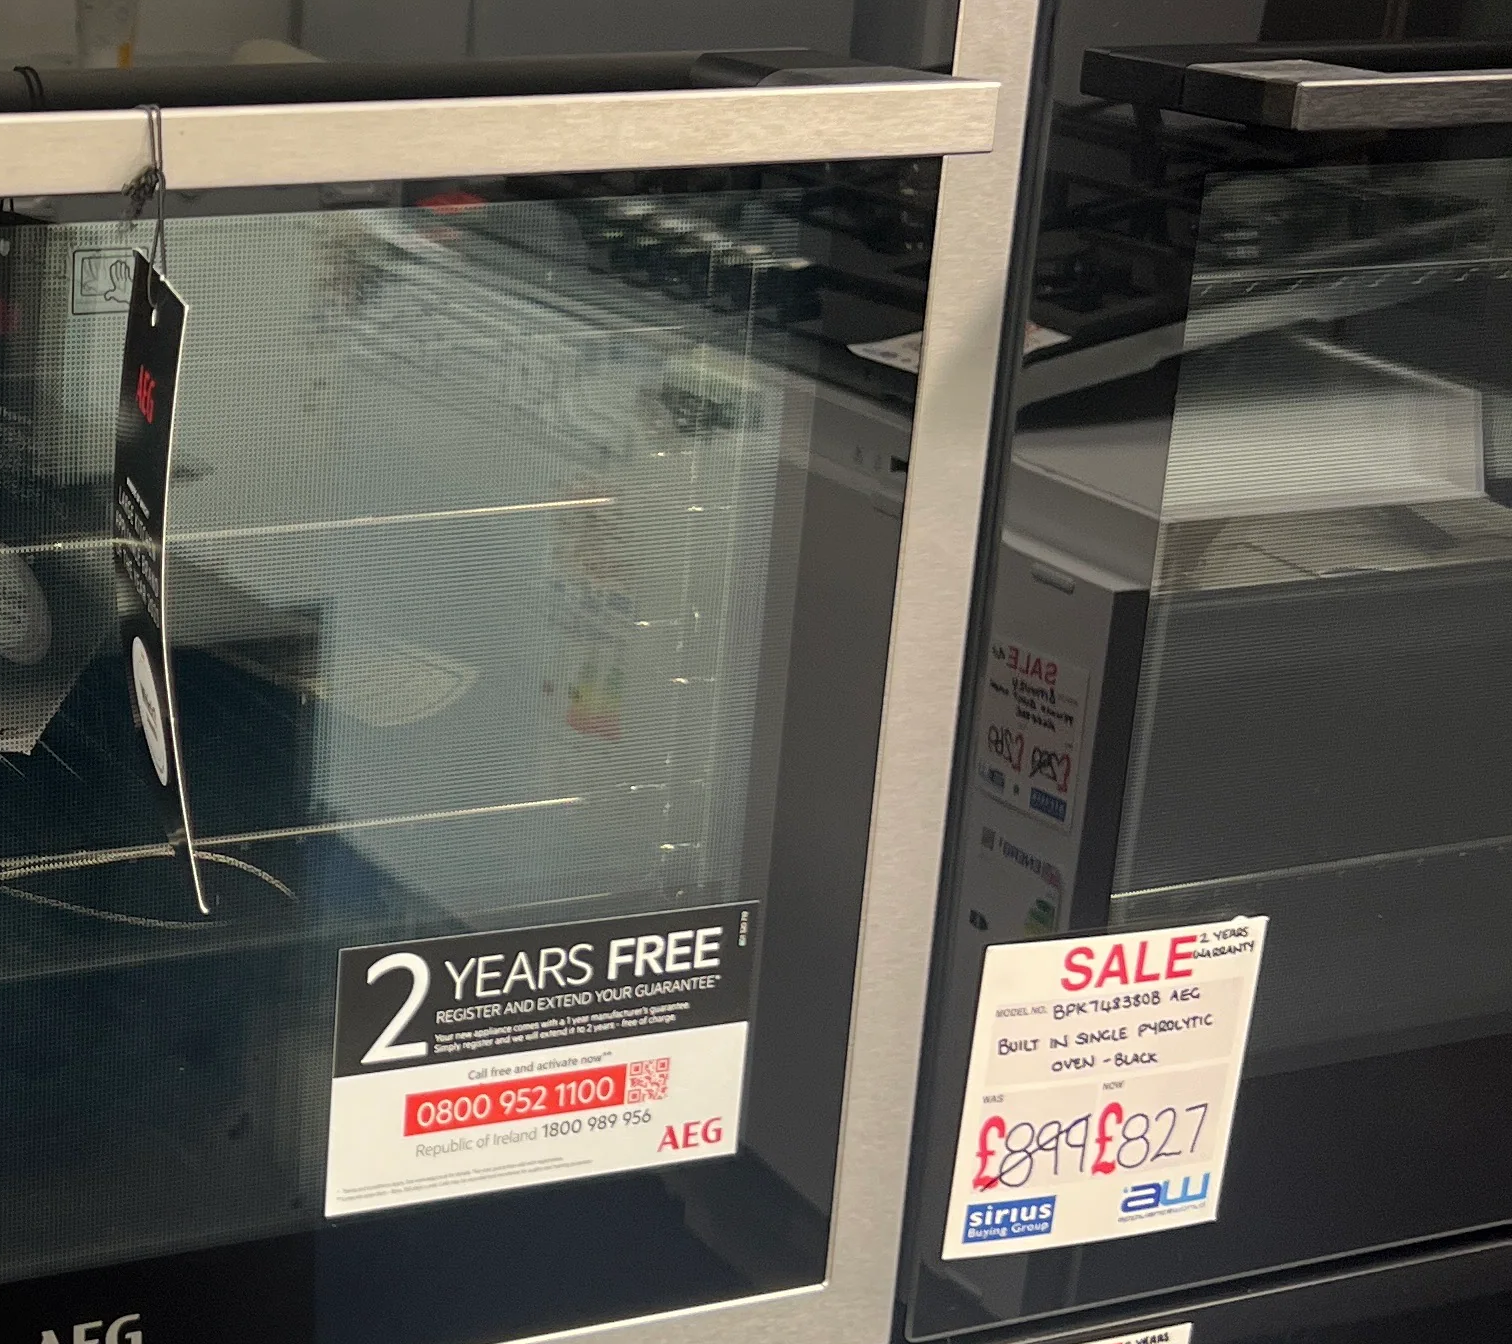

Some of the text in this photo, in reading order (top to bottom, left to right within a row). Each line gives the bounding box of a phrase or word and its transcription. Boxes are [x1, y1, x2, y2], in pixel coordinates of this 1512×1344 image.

[1060, 935, 1198, 992] SALE
[359, 951, 431, 1066] 2
[444, 942, 595, 1001] YEARS
[606, 926, 725, 982] FREE
[435, 1003, 502, 1024] REGISTER
[503, 999, 535, 1015] AND
[536, 990, 592, 1011] EXTEND
[594, 985, 633, 1003] YOUR
[997, 1037, 1039, 1056] BUILT
[1049, 1034, 1069, 1050] IN
[467, 1057, 578, 1081] Call free and activate
[416, 1076, 616, 1128] 0800 952 1100
[415, 1107, 652, 1158] Republic of Ireland 1800 989 956
[656, 1116, 724, 1153] AEG
[968, 1201, 1053, 1228] sirius
